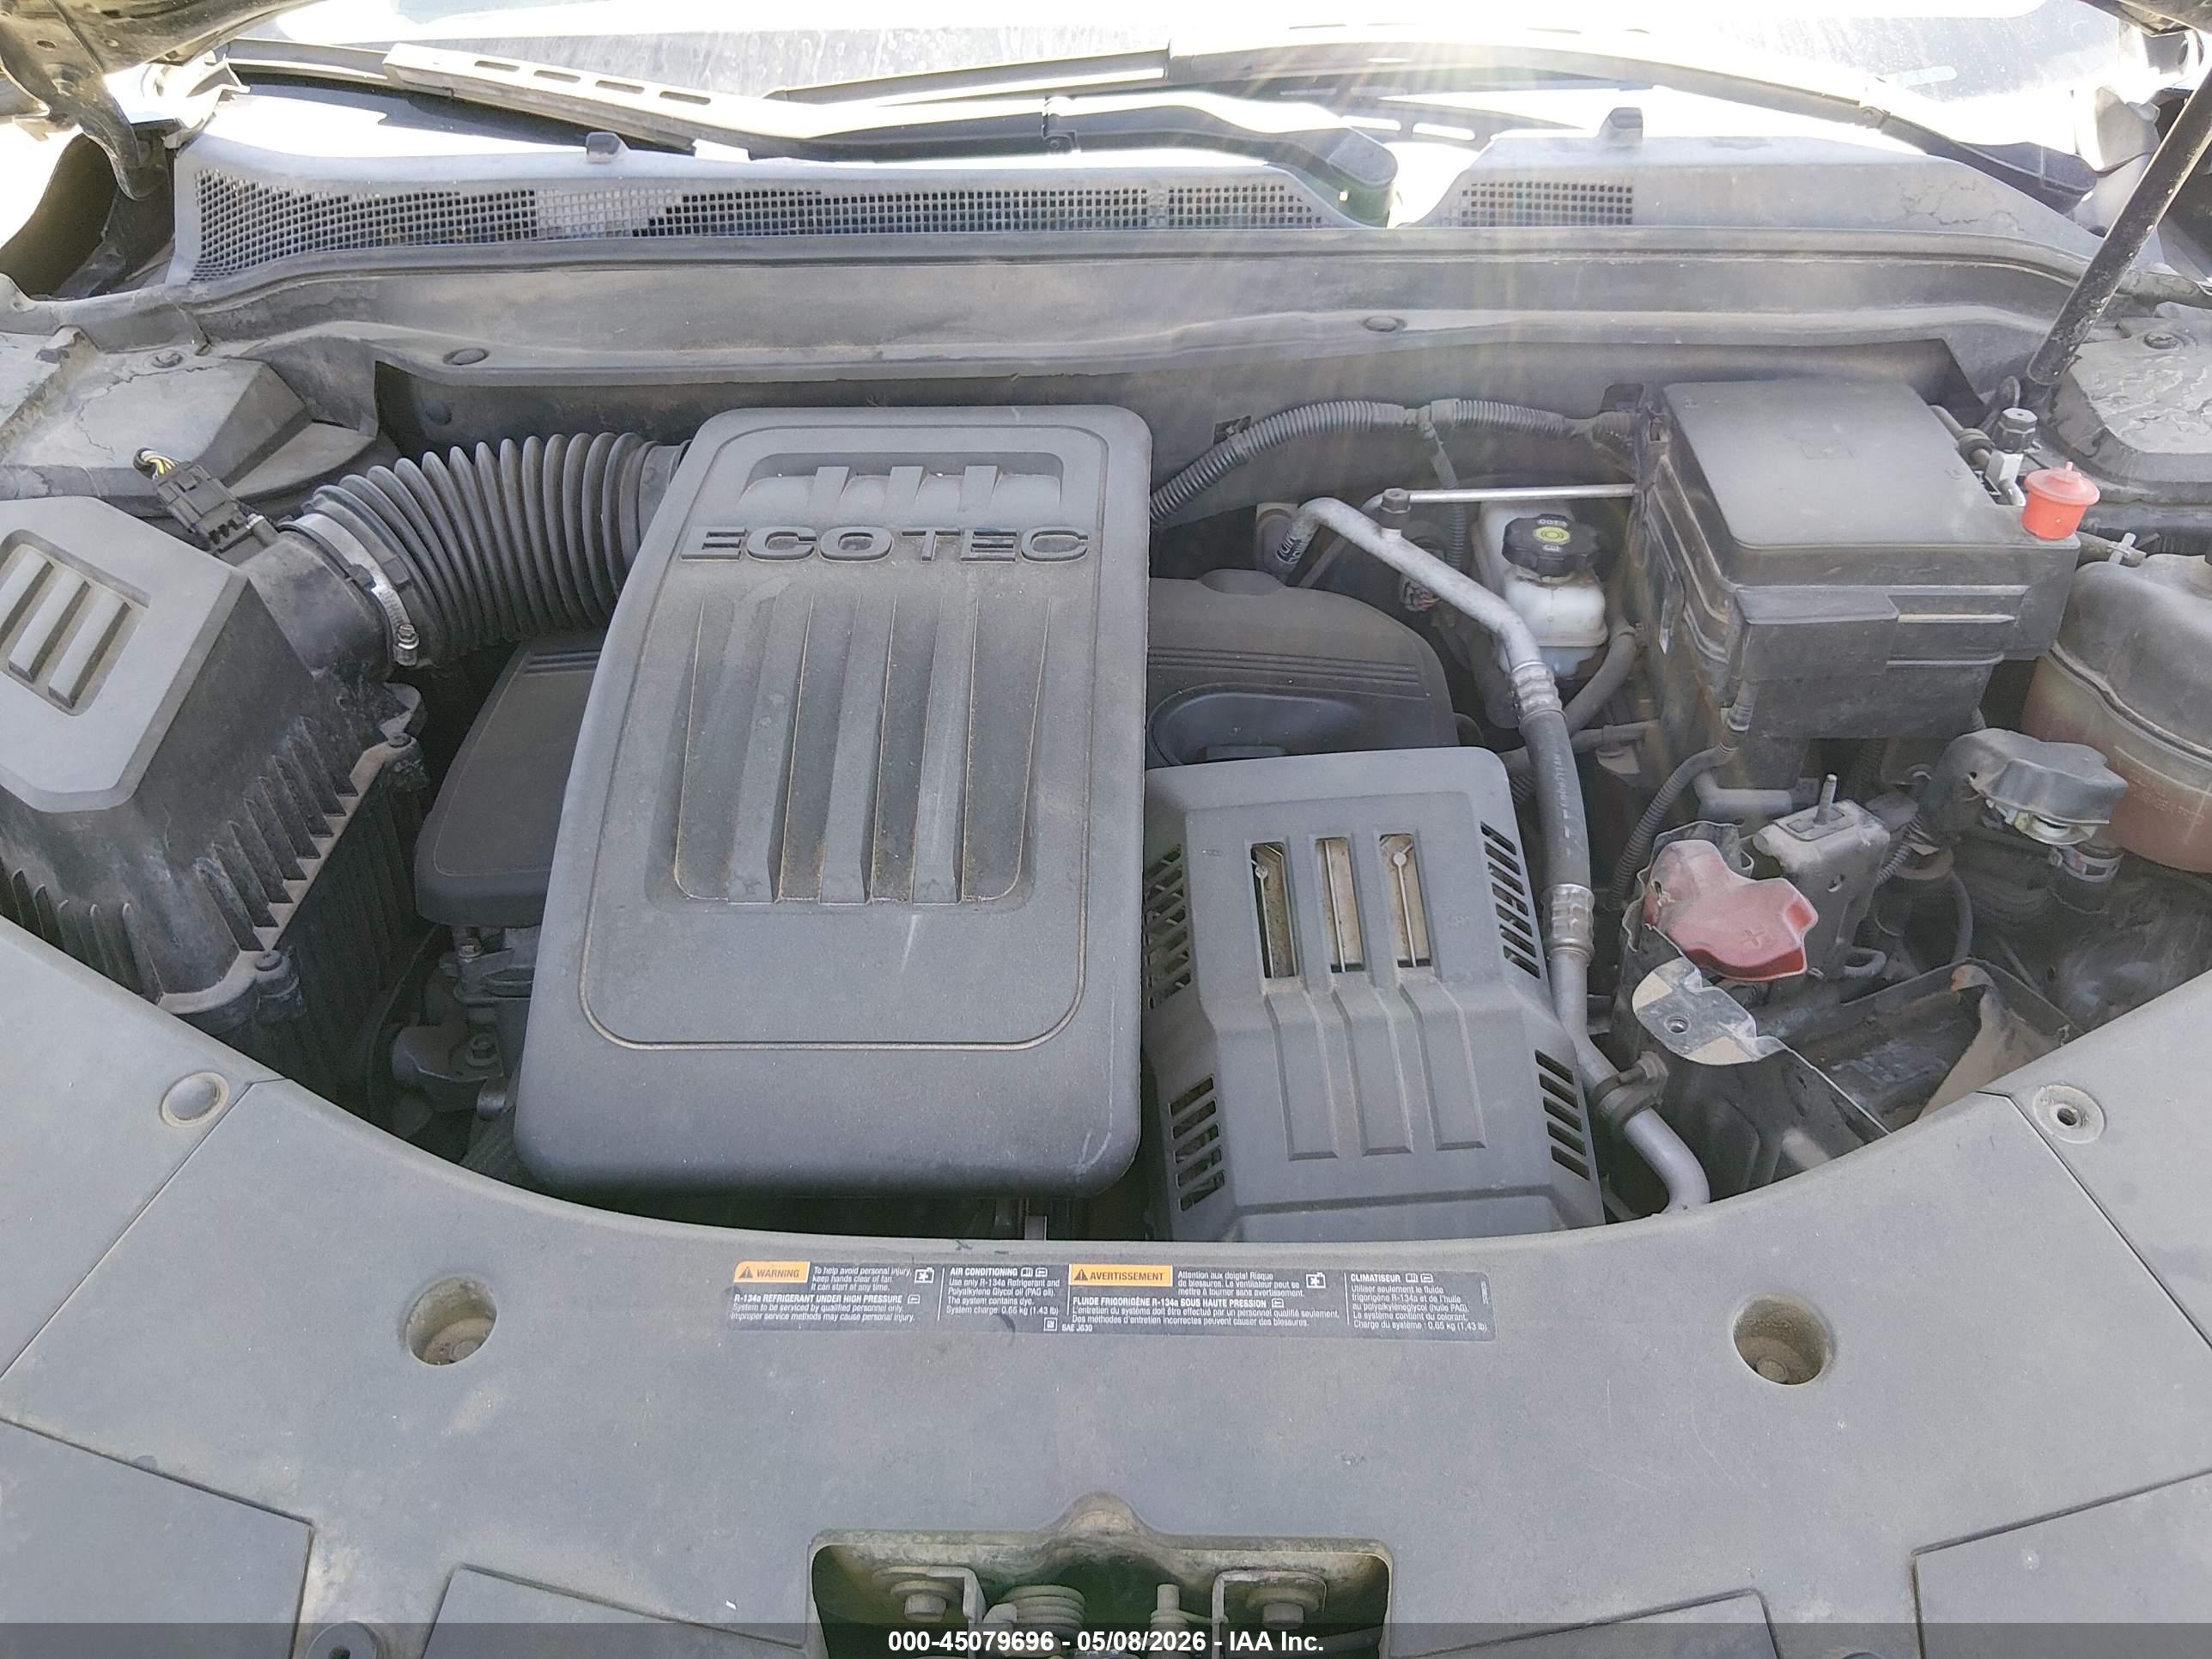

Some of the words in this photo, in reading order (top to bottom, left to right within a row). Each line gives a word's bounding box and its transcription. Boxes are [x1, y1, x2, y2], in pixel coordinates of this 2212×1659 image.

[680, 526, 1090, 563] ECOTEC
[757, 1269, 800, 1279] WARNING
[824, 1267, 840, 1276] help
[840, 1267, 859, 1275] avoid
[860, 1267, 890, 1277] personal
[950, 1267, 963, 1276] AIR
[964, 1267, 1018, 1276] CONDITIONING
[1089, 1272, 1164, 1281] AVERTISSEMENT
[812, 1275, 830, 1284] keep
[1350, 1273, 1401, 1282] CLIMATISEUR
[859, 1284, 871, 1293] any
[963, 1279, 979, 1287] only
[1006, 1279, 1045, 1288] Refrigerant
[734, 1294, 762, 1303] R-134a
[763, 1294, 816, 1303] REFRIGERANT
[816, 1294, 842, 1304] UNDER
[843, 1295, 862, 1304] HIGH
[863, 1295, 902, 1304] PRESSURE
[962, 1297, 988, 1306] system
[1073, 1297, 1099, 1305] FLUIDE
[1180, 1298, 1200, 1307] SOUS
[1202, 1298, 1228, 1307] HAUTE
[1229, 1298, 1267, 1308] PRESSION
[732, 1304, 759, 1313] System
[760, 1304, 768, 1312] to
[769, 1304, 778, 1312] be
[780, 1304, 809, 1312] serviced
[811, 1304, 819, 1313] by
[820, 1304, 850, 1313] qualified
[852, 1304, 887, 1314] personnel
[946, 1305, 972, 1315] System
[1018, 1306, 1029, 1316] kg
[731, 1312, 763, 1321] Improper
[823, 1312, 838, 1322] may
[862, 1313, 891, 1322] personal
